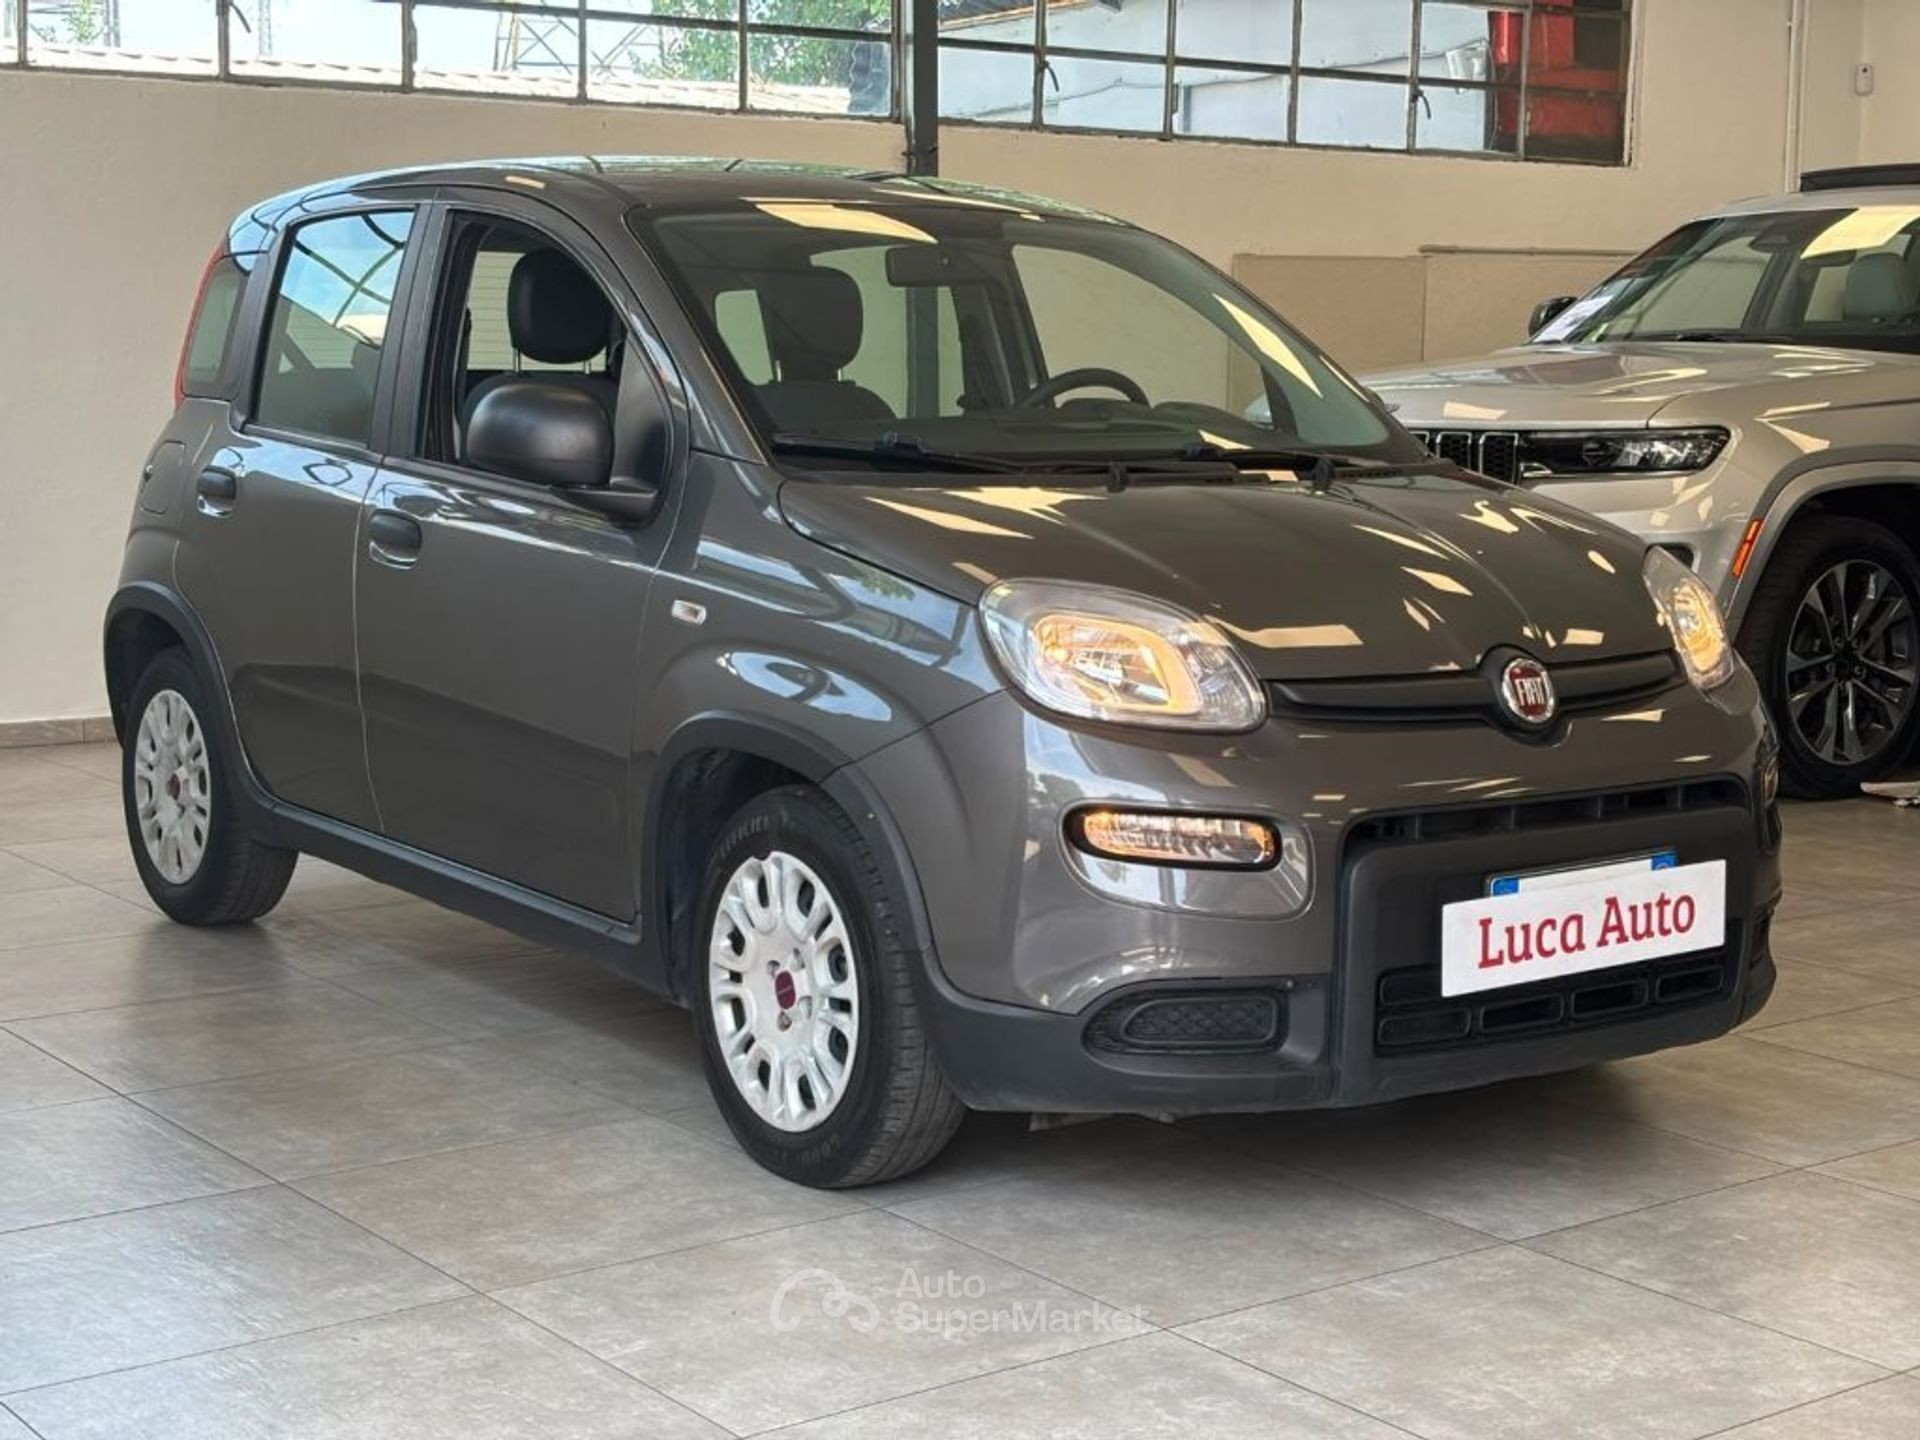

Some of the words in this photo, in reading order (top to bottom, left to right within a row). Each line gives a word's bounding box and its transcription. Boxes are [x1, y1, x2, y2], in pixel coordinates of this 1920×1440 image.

[1514, 676, 1545, 706] FIAT
[1478, 913, 1585, 969] Luca
[1597, 892, 1696, 948] Auto
